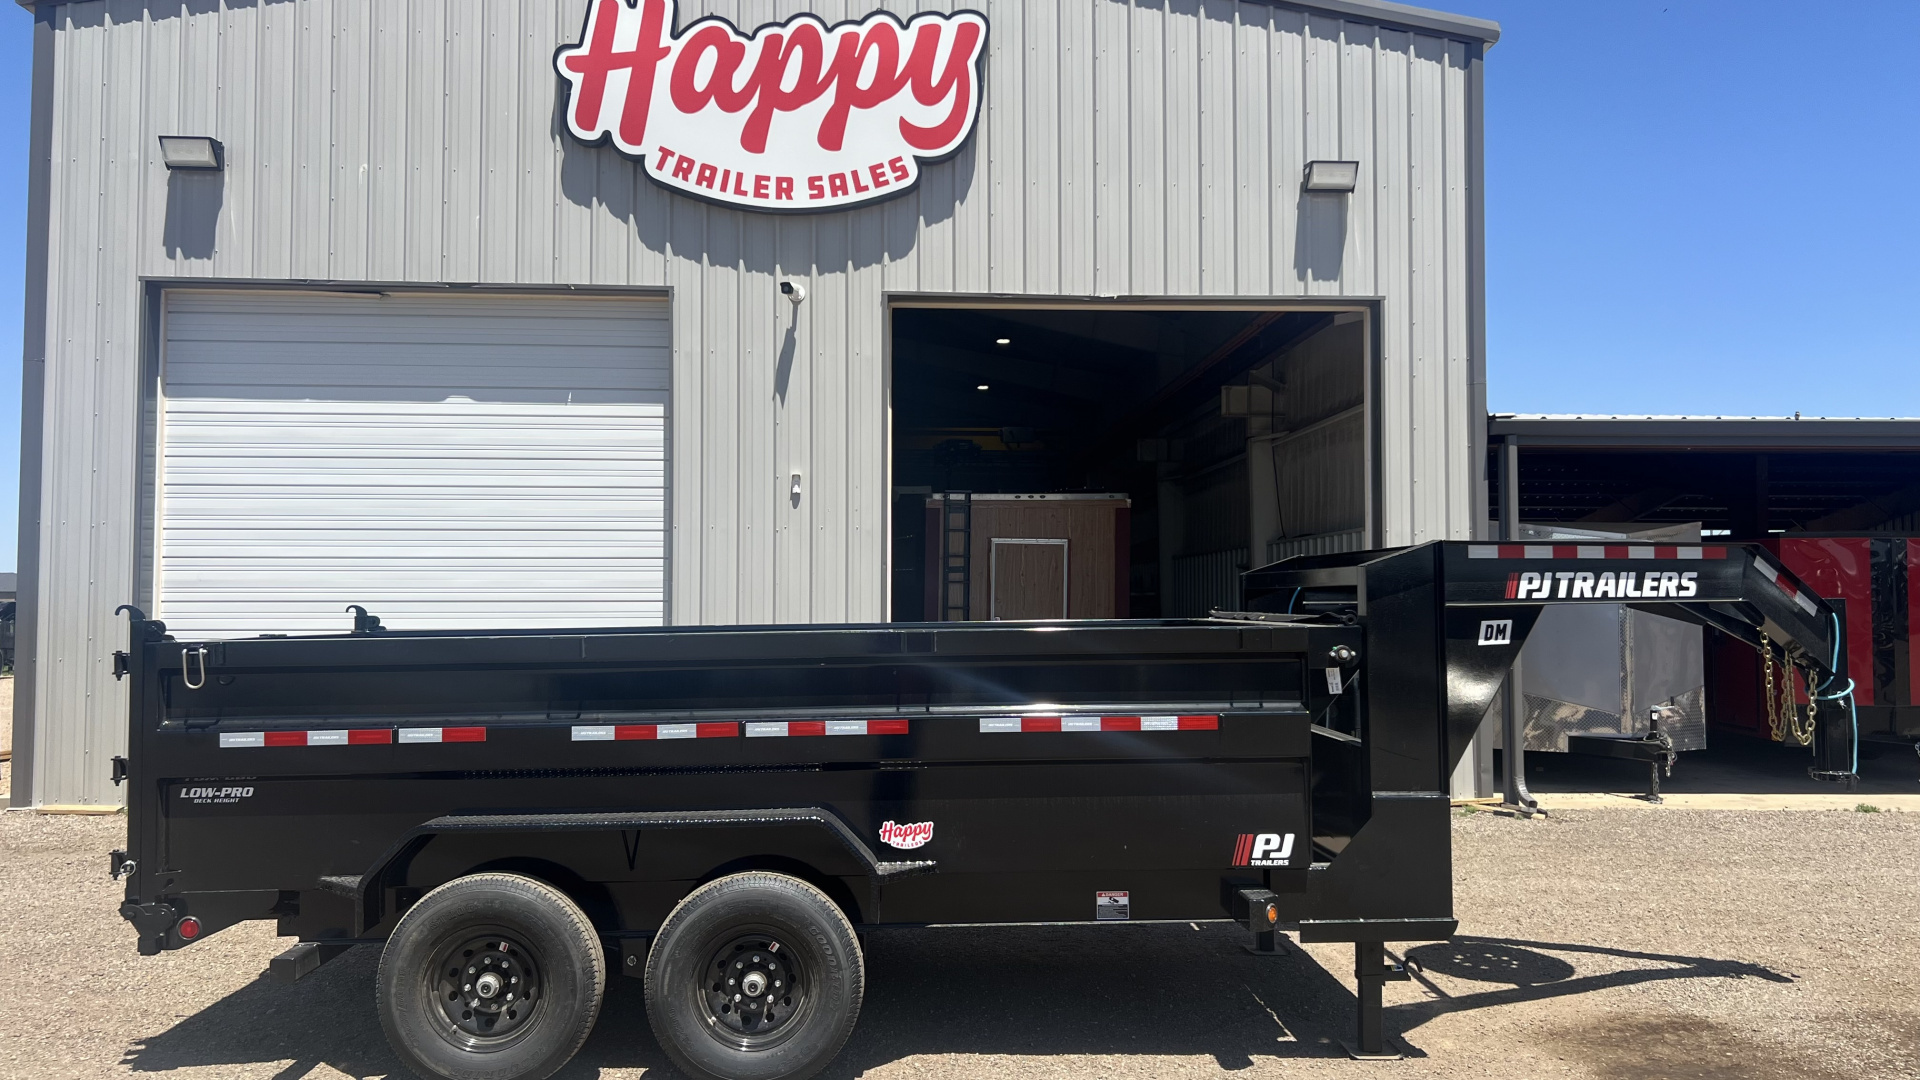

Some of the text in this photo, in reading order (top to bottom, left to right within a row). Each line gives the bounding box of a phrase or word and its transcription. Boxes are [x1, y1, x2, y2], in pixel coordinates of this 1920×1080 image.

[565, 0, 980, 154] Happy
[656, 145, 911, 201] TRAILER SALES
[1517, 571, 1698, 599] PJ TRAILERS
[1484, 624, 1508, 642] DM
[180, 786, 254, 798] LOW-PRO
[881, 822, 932, 842] Happy
[1251, 833, 1296, 859] PJ
